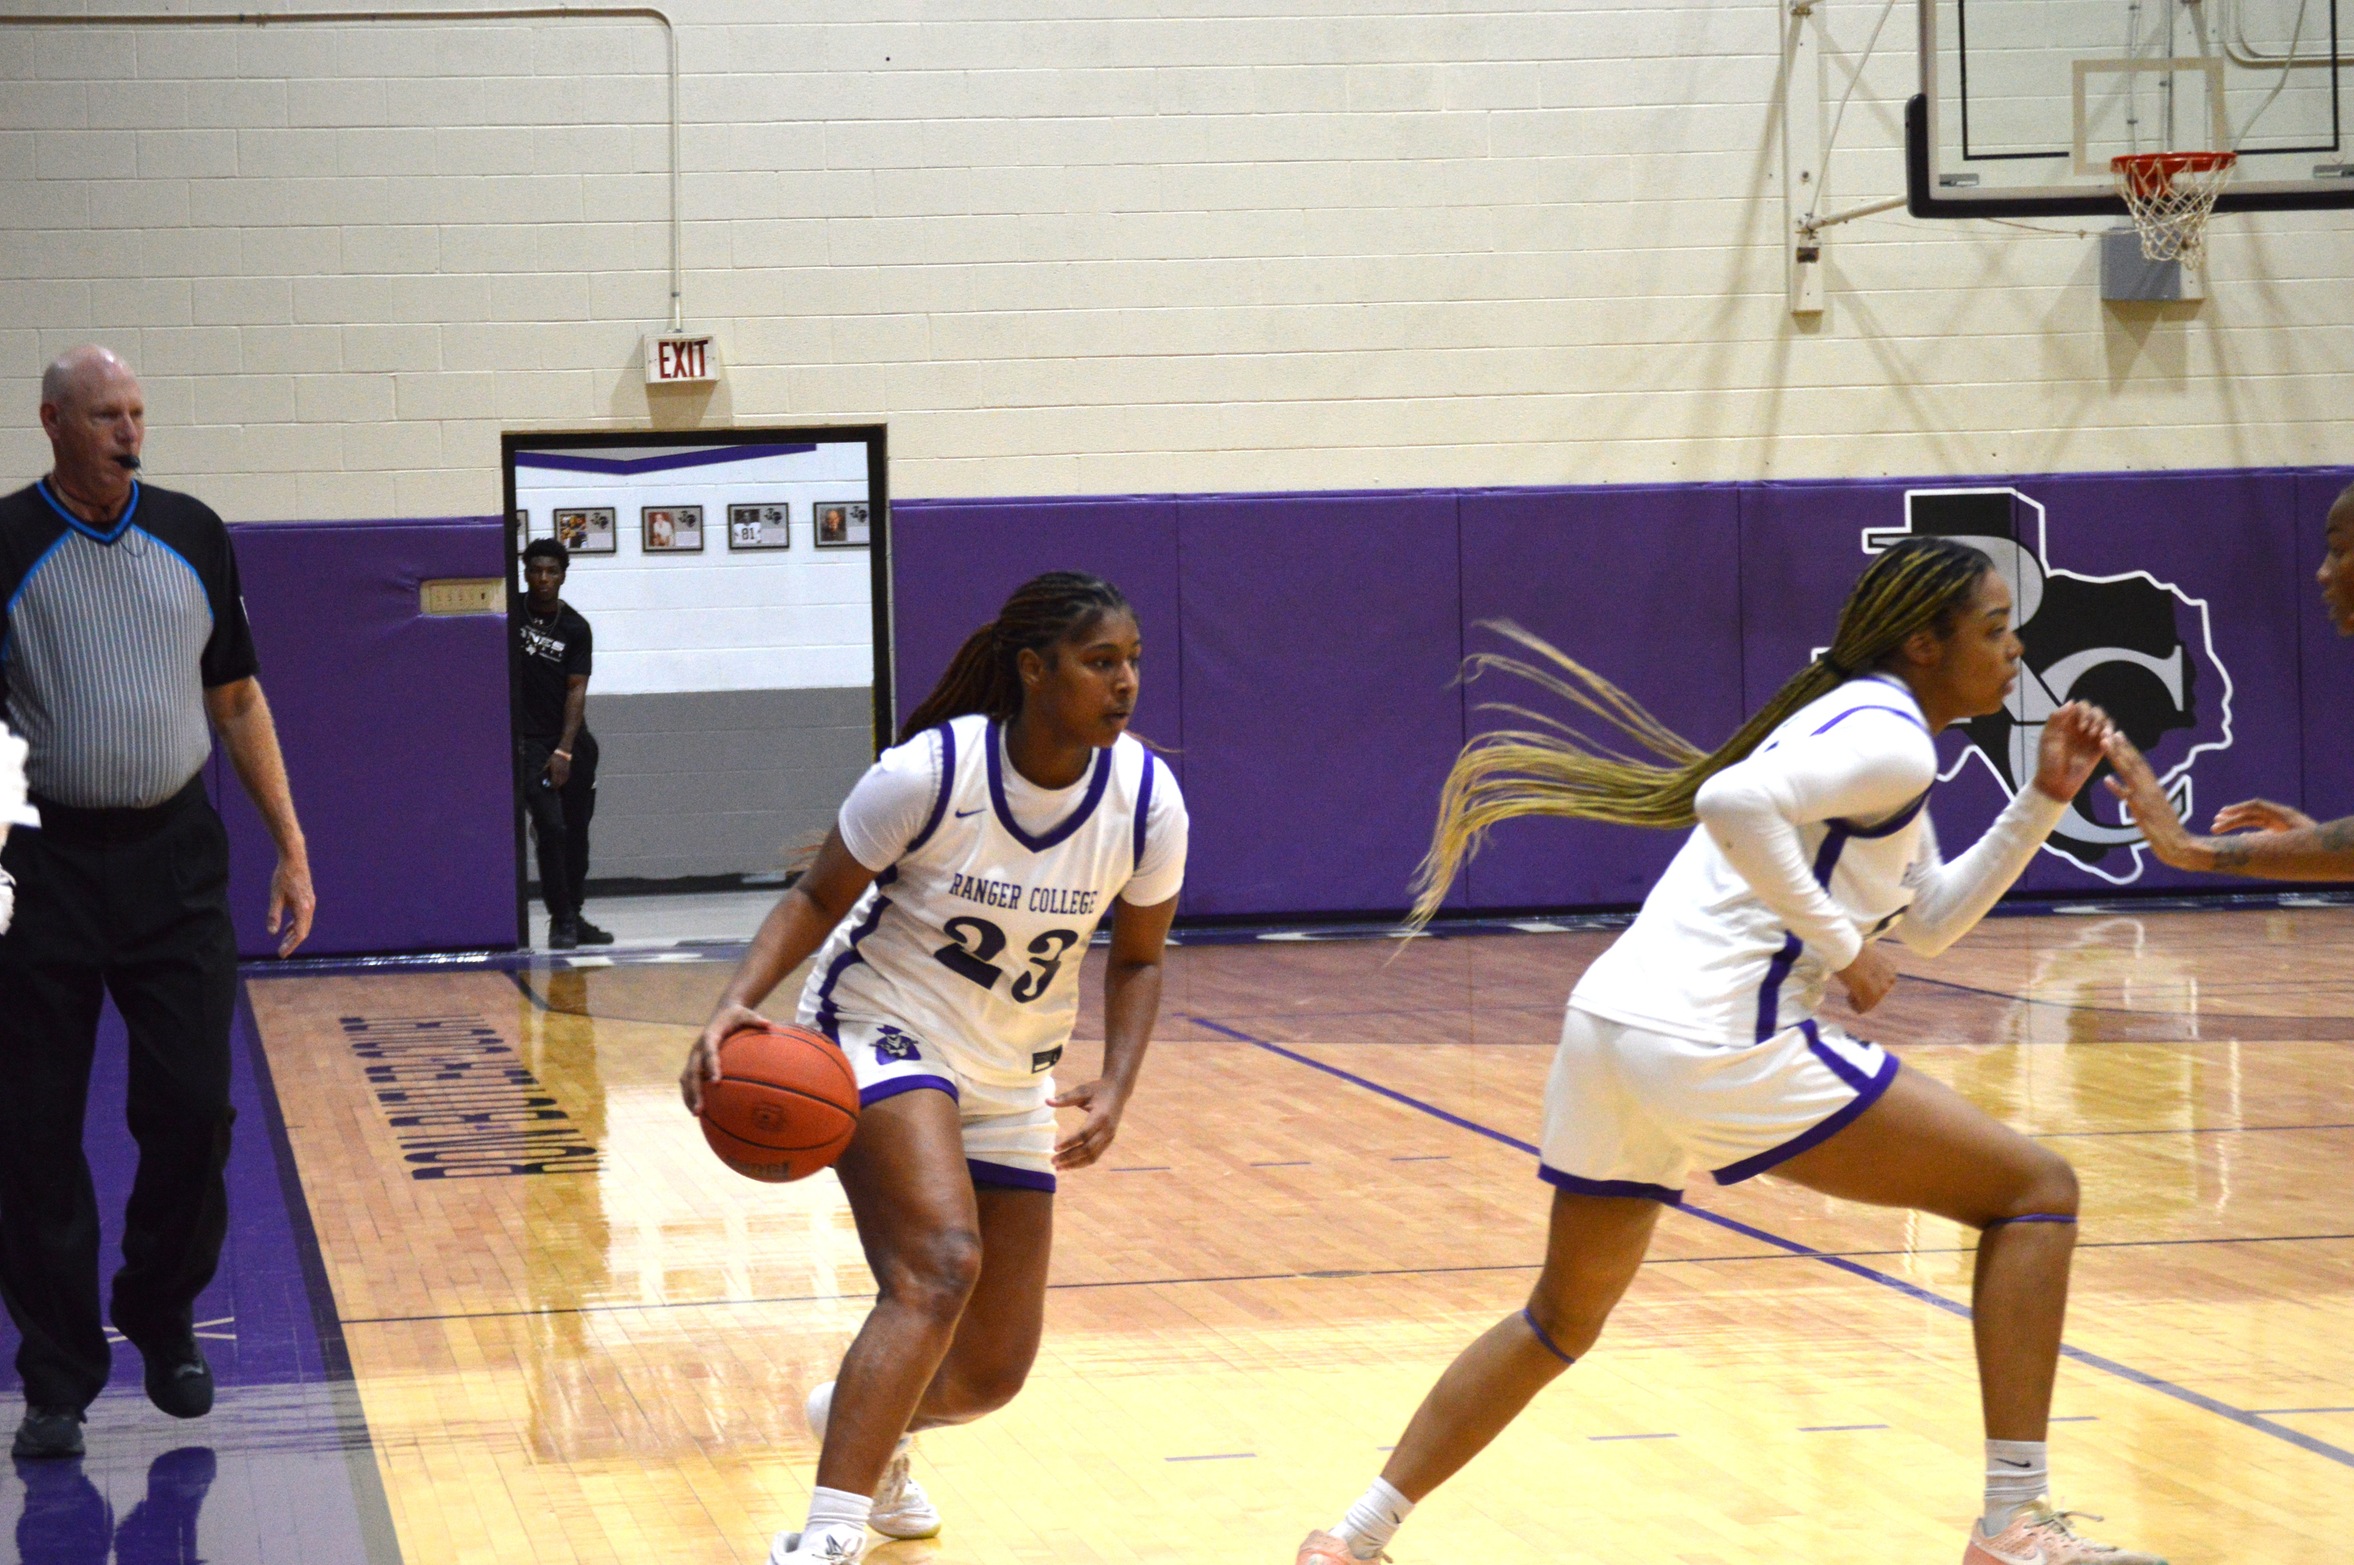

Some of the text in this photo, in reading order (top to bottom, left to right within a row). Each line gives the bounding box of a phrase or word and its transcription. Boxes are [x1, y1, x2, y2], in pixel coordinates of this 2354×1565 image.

[657, 340, 708, 379] EXIT
[741, 527, 755, 541] 81
[948, 873, 1098, 916] RANGER COLLEGE
[934, 916, 1079, 1004] 23
